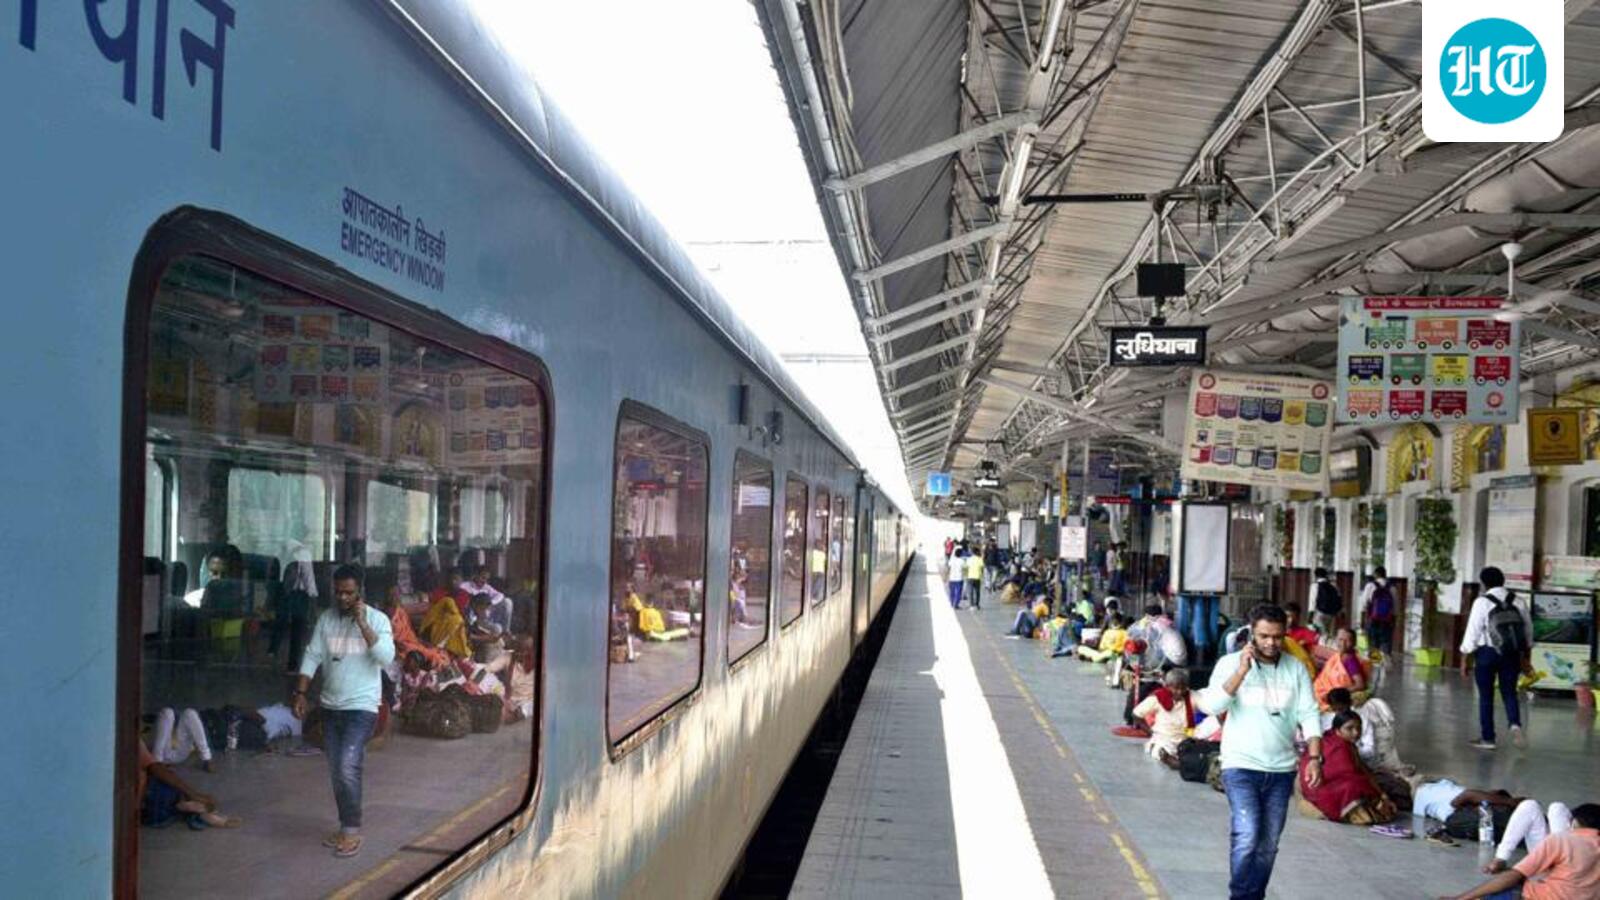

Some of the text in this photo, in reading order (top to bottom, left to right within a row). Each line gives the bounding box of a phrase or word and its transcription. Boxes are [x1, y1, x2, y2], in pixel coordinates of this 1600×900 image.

[341, 220, 446, 293] EMERGENCY WINDOW
[342, 186, 446, 266] आपातकालीन खिड़की
[1115, 332, 1198, 359] लुधियाना
